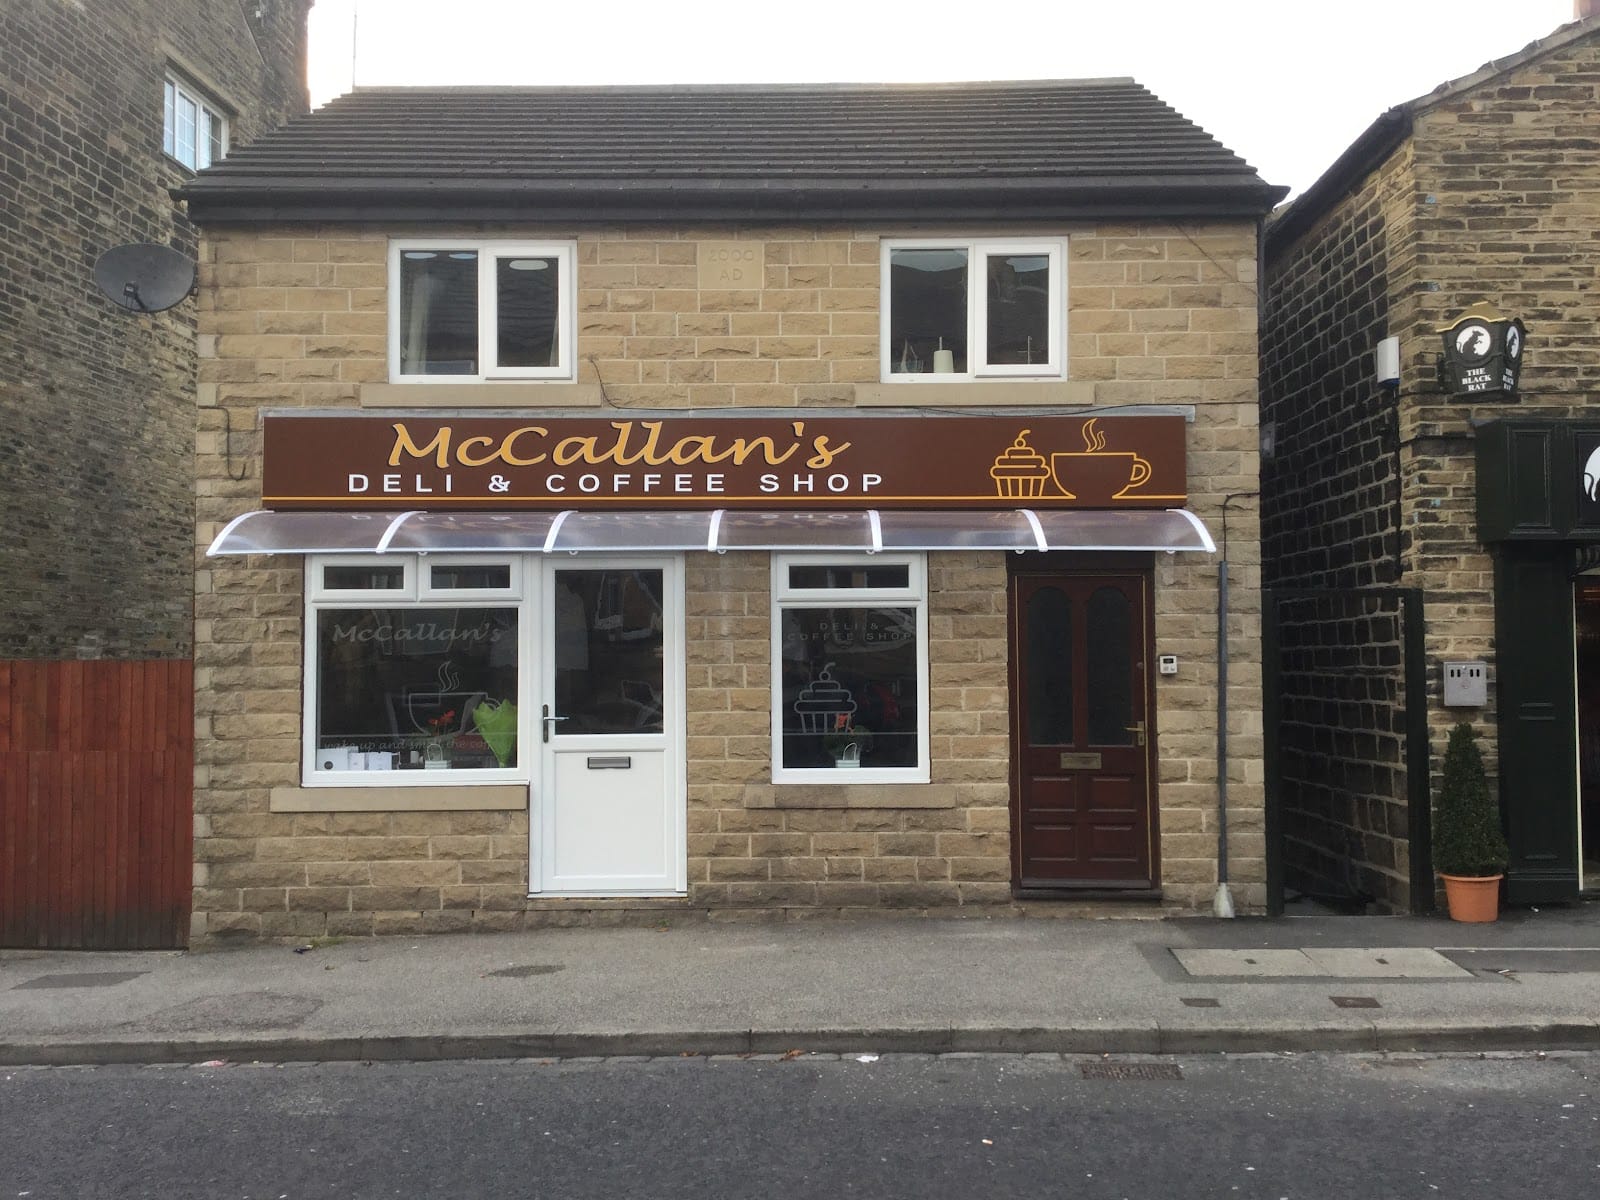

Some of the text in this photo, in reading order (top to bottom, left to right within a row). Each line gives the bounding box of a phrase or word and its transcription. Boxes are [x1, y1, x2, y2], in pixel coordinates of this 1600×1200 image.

[720, 268, 743, 280] AD
[1466, 368, 1486, 376] THE
[1462, 375, 1491, 385] BLACK
[1468, 383, 1486, 391] RAT
[388, 421, 851, 468] McCallan's
[347, 473, 883, 493] DELI & COFFEE SHOP
[819, 622, 879, 631] DELI &
[332, 622, 502, 642] McCallan's
[787, 632, 913, 641] COFFEE SHOP
